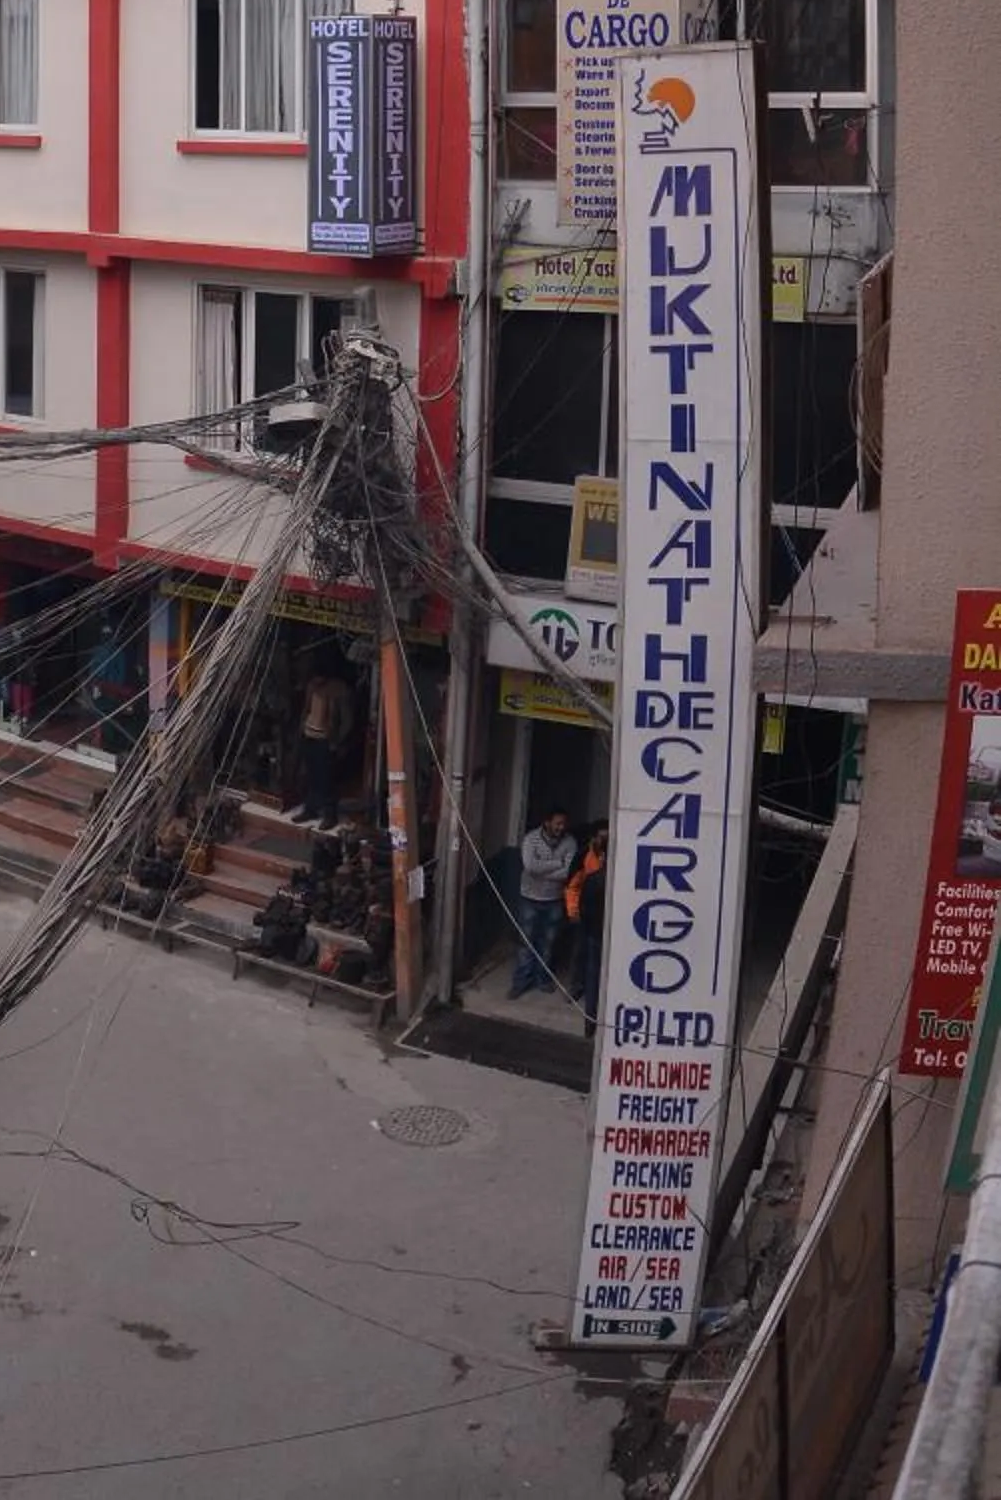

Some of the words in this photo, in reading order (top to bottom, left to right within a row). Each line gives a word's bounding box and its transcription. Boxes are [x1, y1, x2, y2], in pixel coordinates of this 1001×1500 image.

[311, 19, 370, 38] HOTEL
[374, 21, 415, 39] HOTEL
[565, 12, 670, 48] CARGO
[326, 41, 354, 219] SERENITY
[385, 42, 405, 219] SERENITY
[534, 257, 576, 276] Hotel
[644, 164, 714, 684] MUKTINATH
[964, 643, 1001, 669] DA
[932, 921, 963, 937] Free
[929, 939, 956, 955] LED
[926, 958, 976, 975] Mobile
[656, 1010, 714, 1047] LTD
[609, 1058, 712, 1091] WORLDWIDE
[618, 1094, 699, 1124] FREIGHT
[603, 1126, 711, 1158] FORWARDER
[612, 1160, 693, 1189] PACKING
[609, 1192, 687, 1220] CUSTOM
[590, 1224, 696, 1251] CLEARANCE
